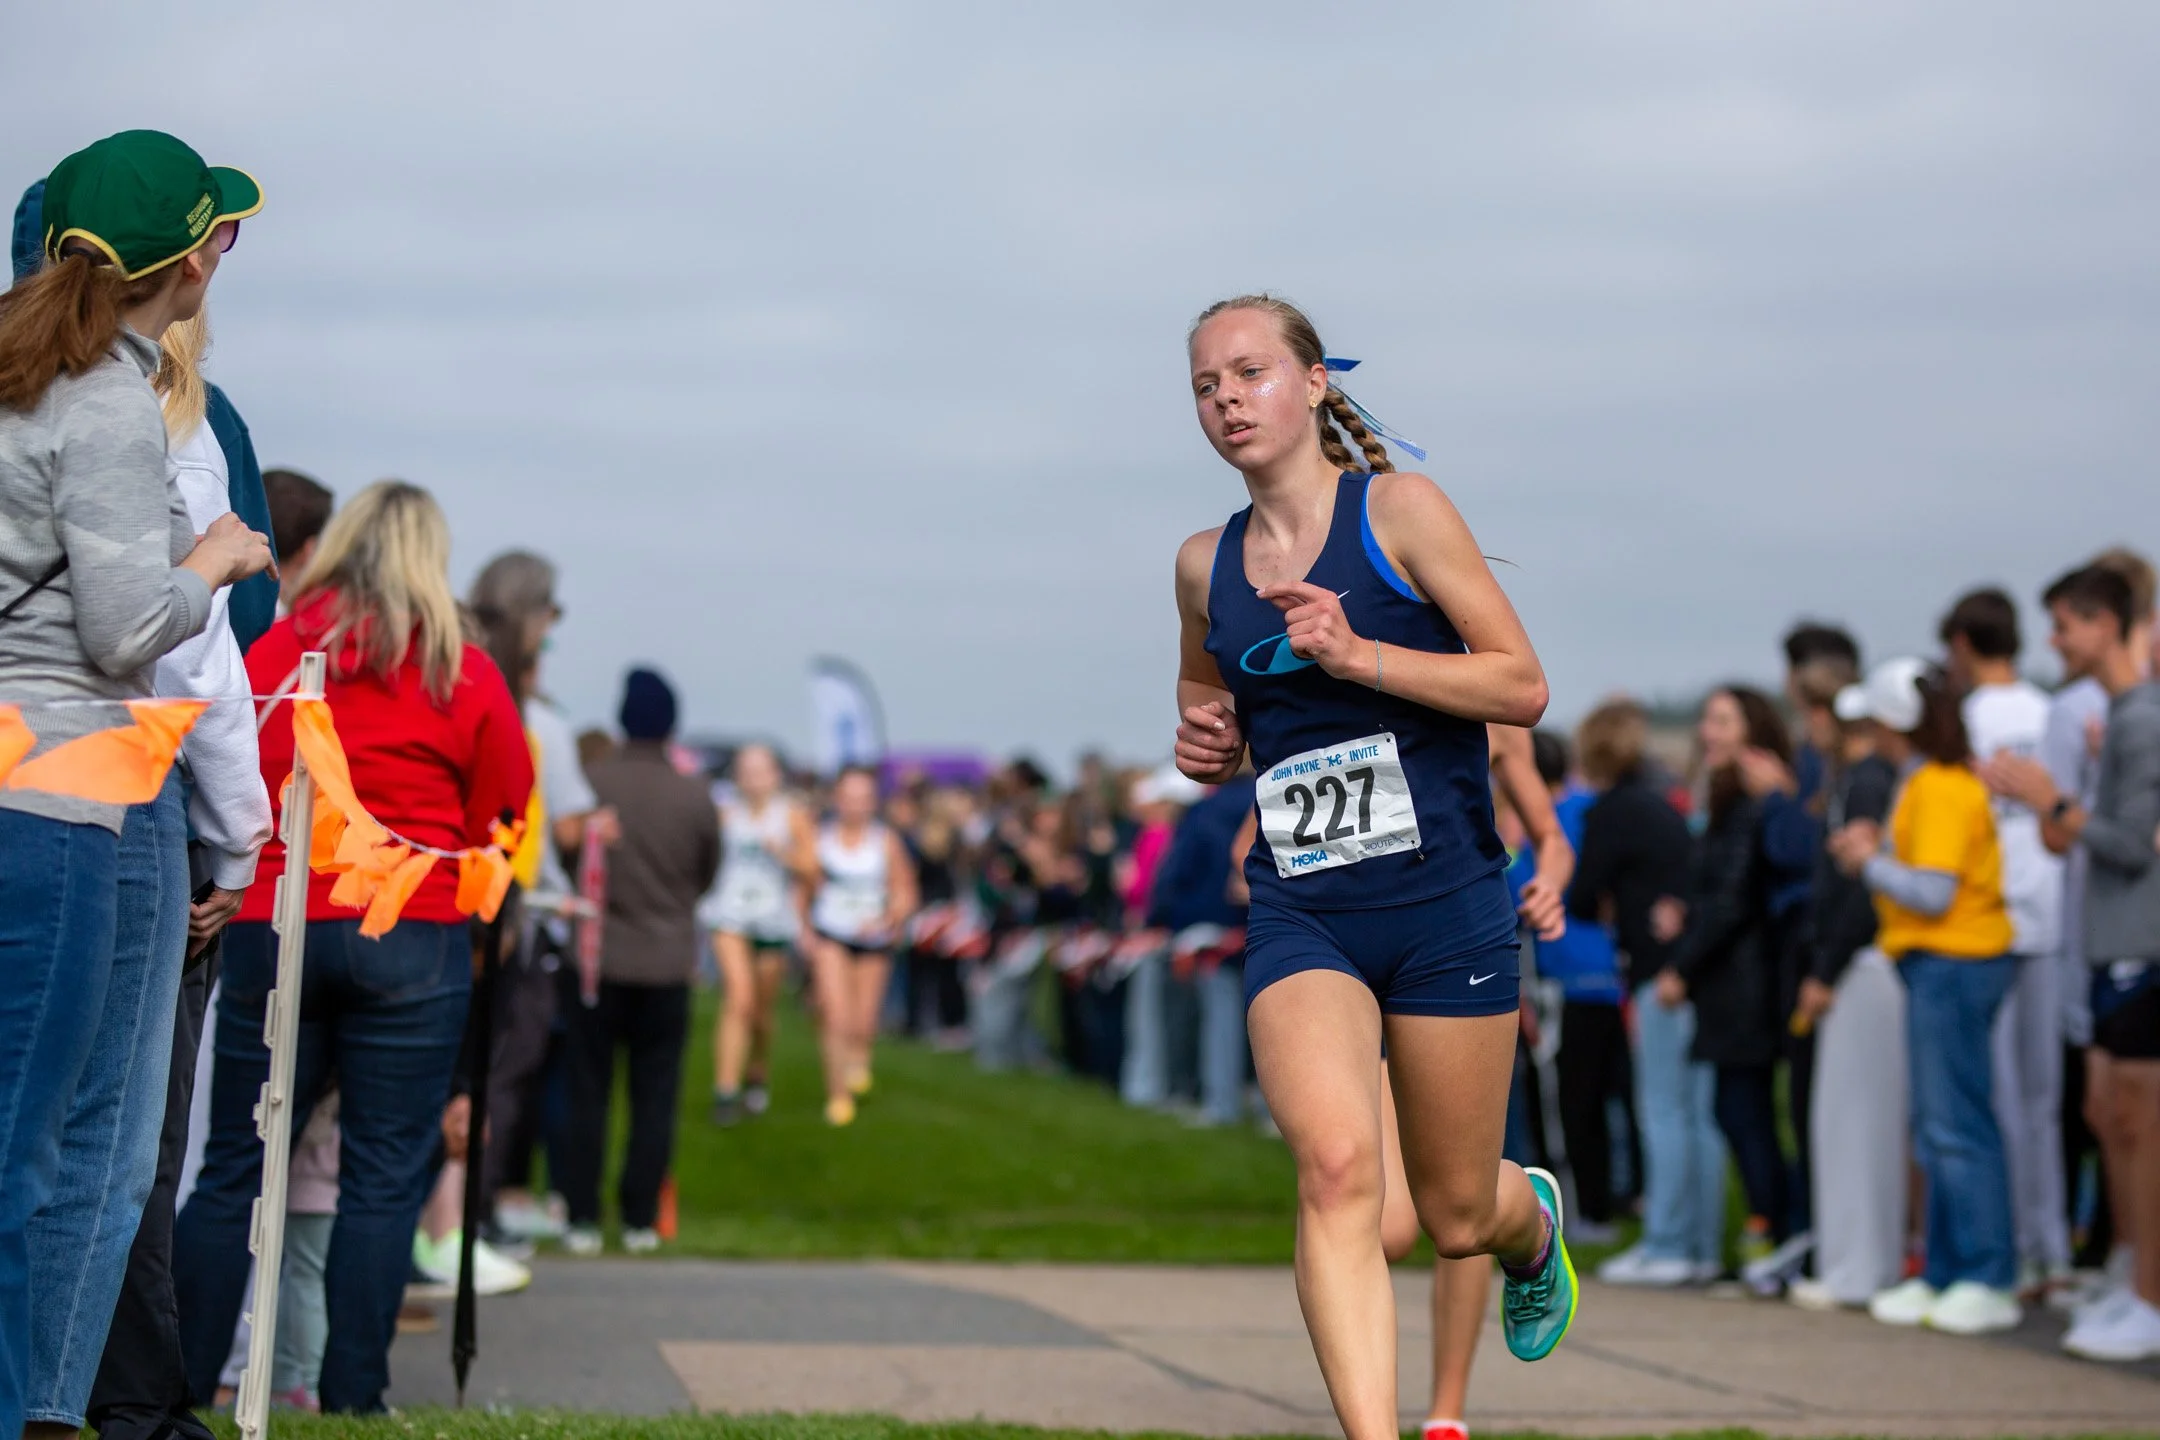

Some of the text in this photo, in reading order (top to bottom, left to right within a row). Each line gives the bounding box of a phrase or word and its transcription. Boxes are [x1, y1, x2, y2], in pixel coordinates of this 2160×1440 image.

[189, 201, 215, 237] MUSTAN
[1271, 765, 1293, 781] JOHN
[1294, 759, 1321, 775] PAYNE
[1349, 745, 1379, 762] INVITE
[1285, 766, 1375, 847] 227
[1292, 850, 1328, 868] HOKA
